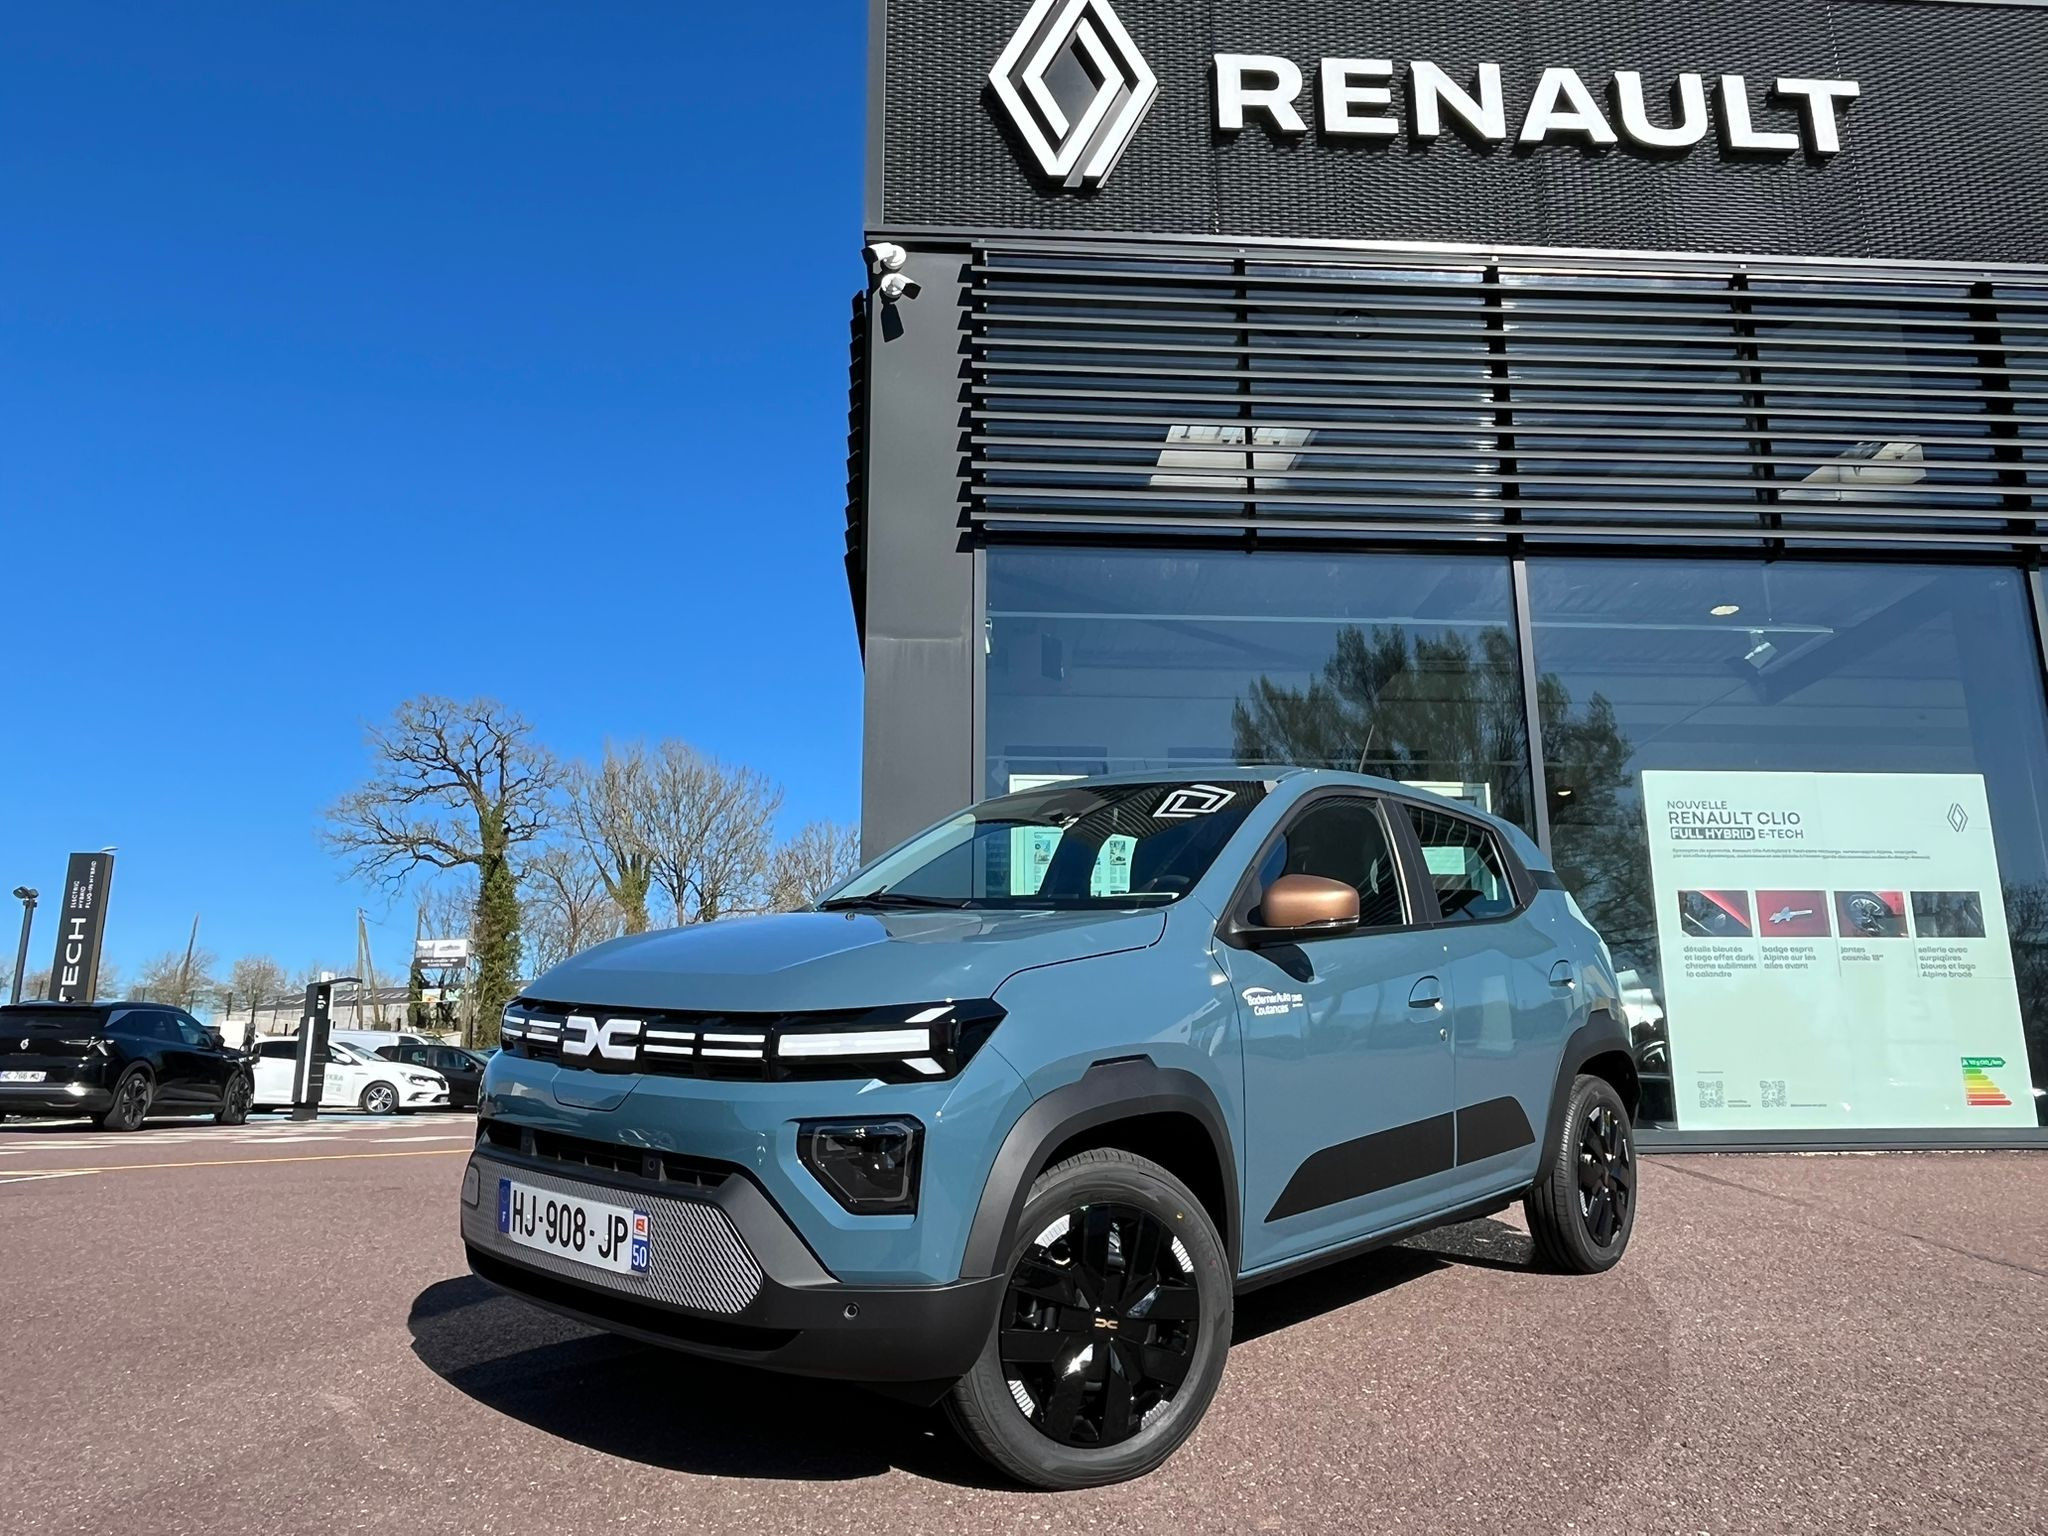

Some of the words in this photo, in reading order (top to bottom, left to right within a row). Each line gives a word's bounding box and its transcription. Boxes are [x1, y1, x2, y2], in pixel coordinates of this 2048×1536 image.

[1213, 54, 1860, 153] RENAULT
[1667, 800, 1728, 810] NOUVELLE
[1668, 811, 1753, 825] RENAULT
[1757, 811, 1801, 825] CLIO
[1671, 828, 1704, 839] FULL
[1705, 828, 1754, 839] HYBRID
[1758, 829, 1804, 839] E-TECH
[512, 1189, 629, 1262] HJ-908-JP
[632, 1244, 647, 1268] 50
